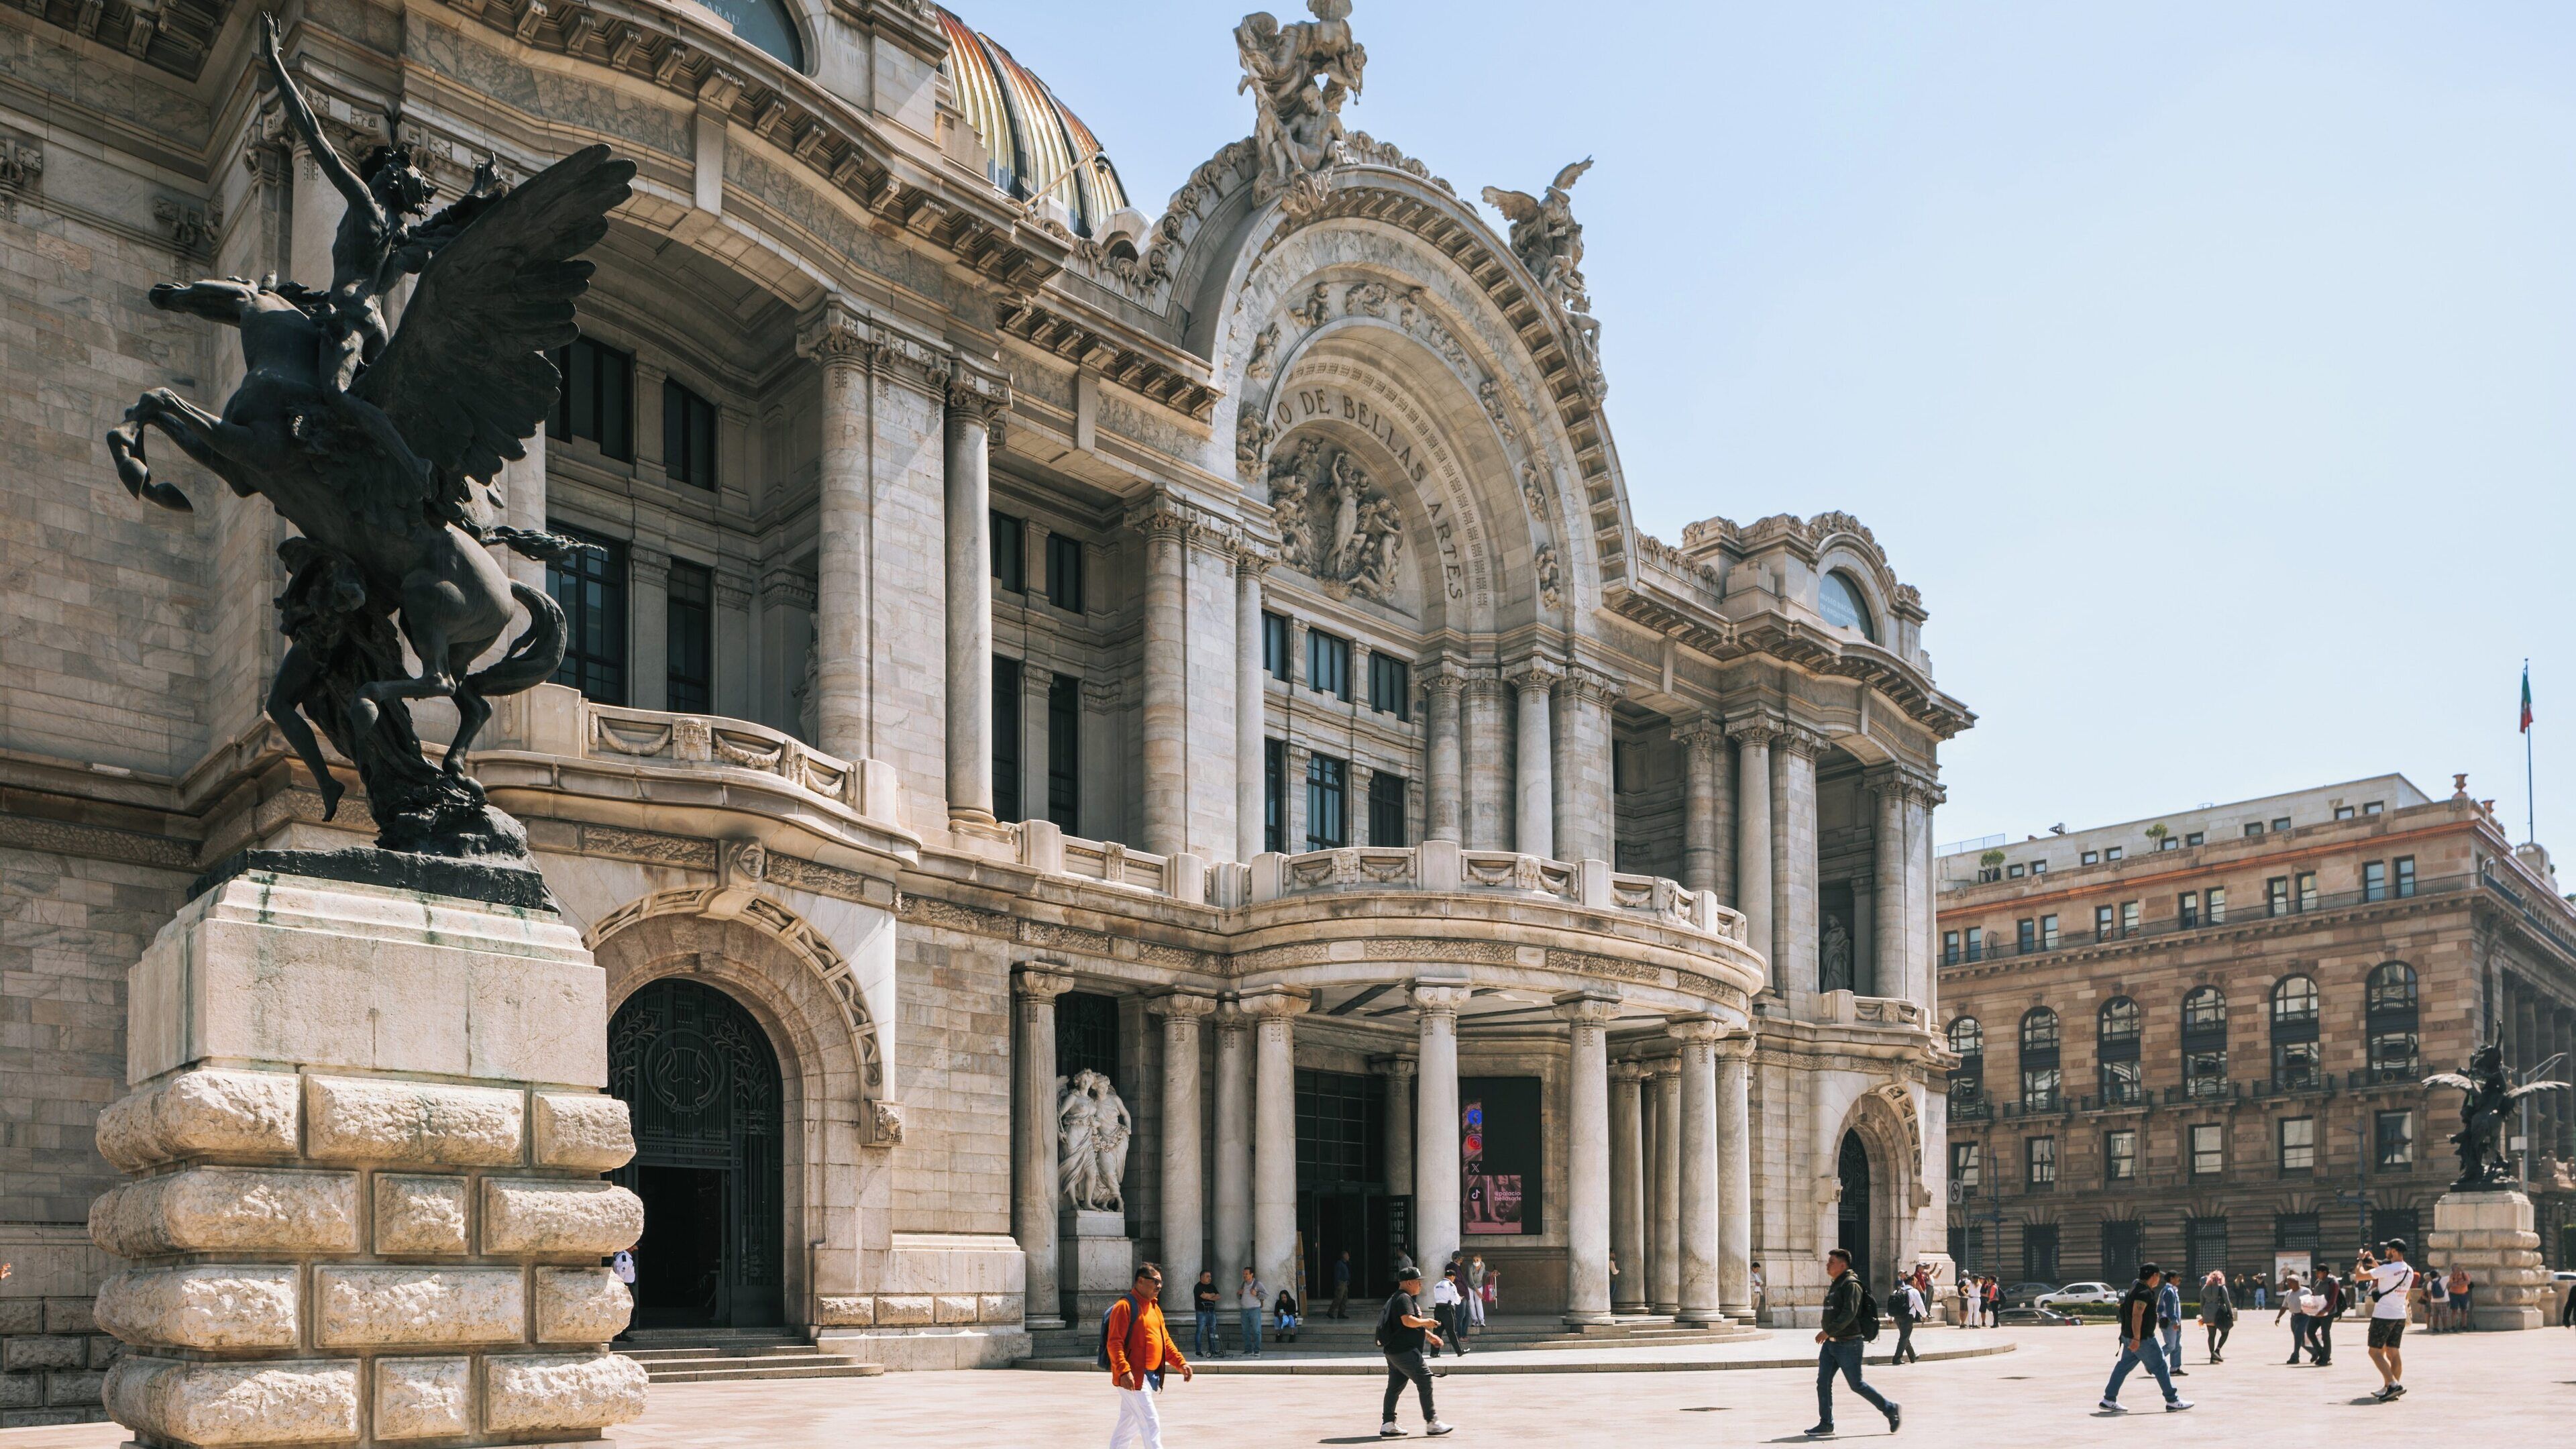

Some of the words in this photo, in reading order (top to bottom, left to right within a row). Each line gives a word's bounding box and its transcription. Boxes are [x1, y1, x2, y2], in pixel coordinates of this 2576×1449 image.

[1299, 388, 1330, 415] DE
[1343, 394, 1424, 482] BELLAS
[1428, 503, 1463, 600] ARTES
